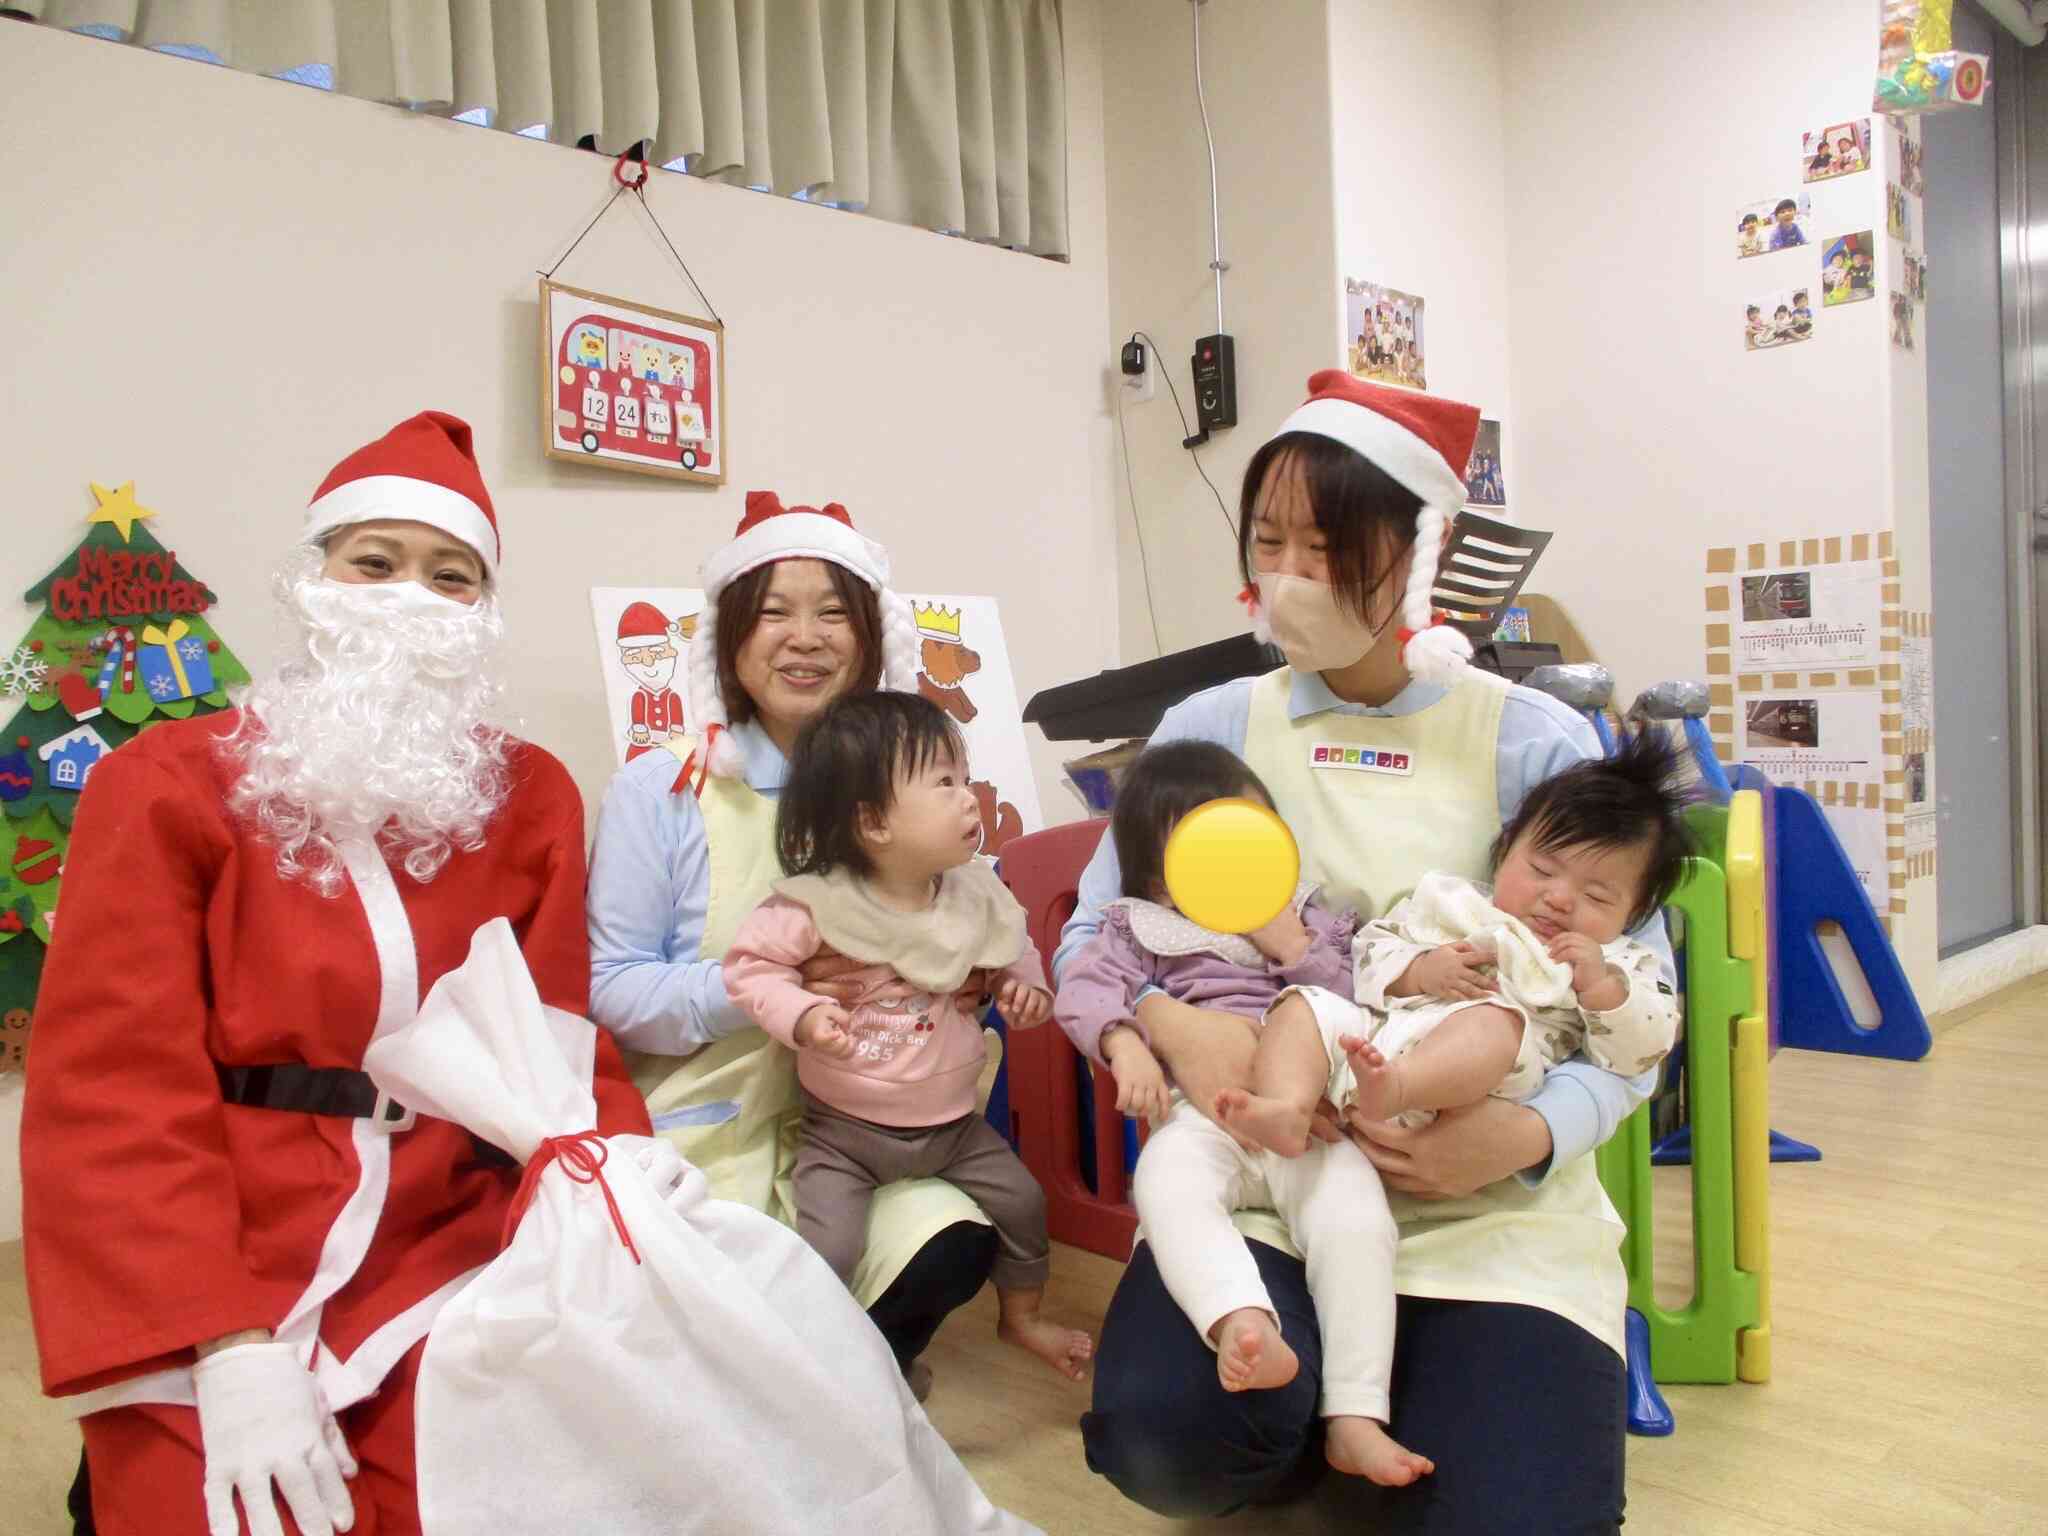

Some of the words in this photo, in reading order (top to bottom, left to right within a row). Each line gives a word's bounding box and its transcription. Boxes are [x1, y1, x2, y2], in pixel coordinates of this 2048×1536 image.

[587, 398, 605, 416] 12
[617, 404, 636, 423] 24
[650, 411, 668, 423] すい
[78, 546, 177, 585] Merry
[52, 577, 209, 621] Christmas
